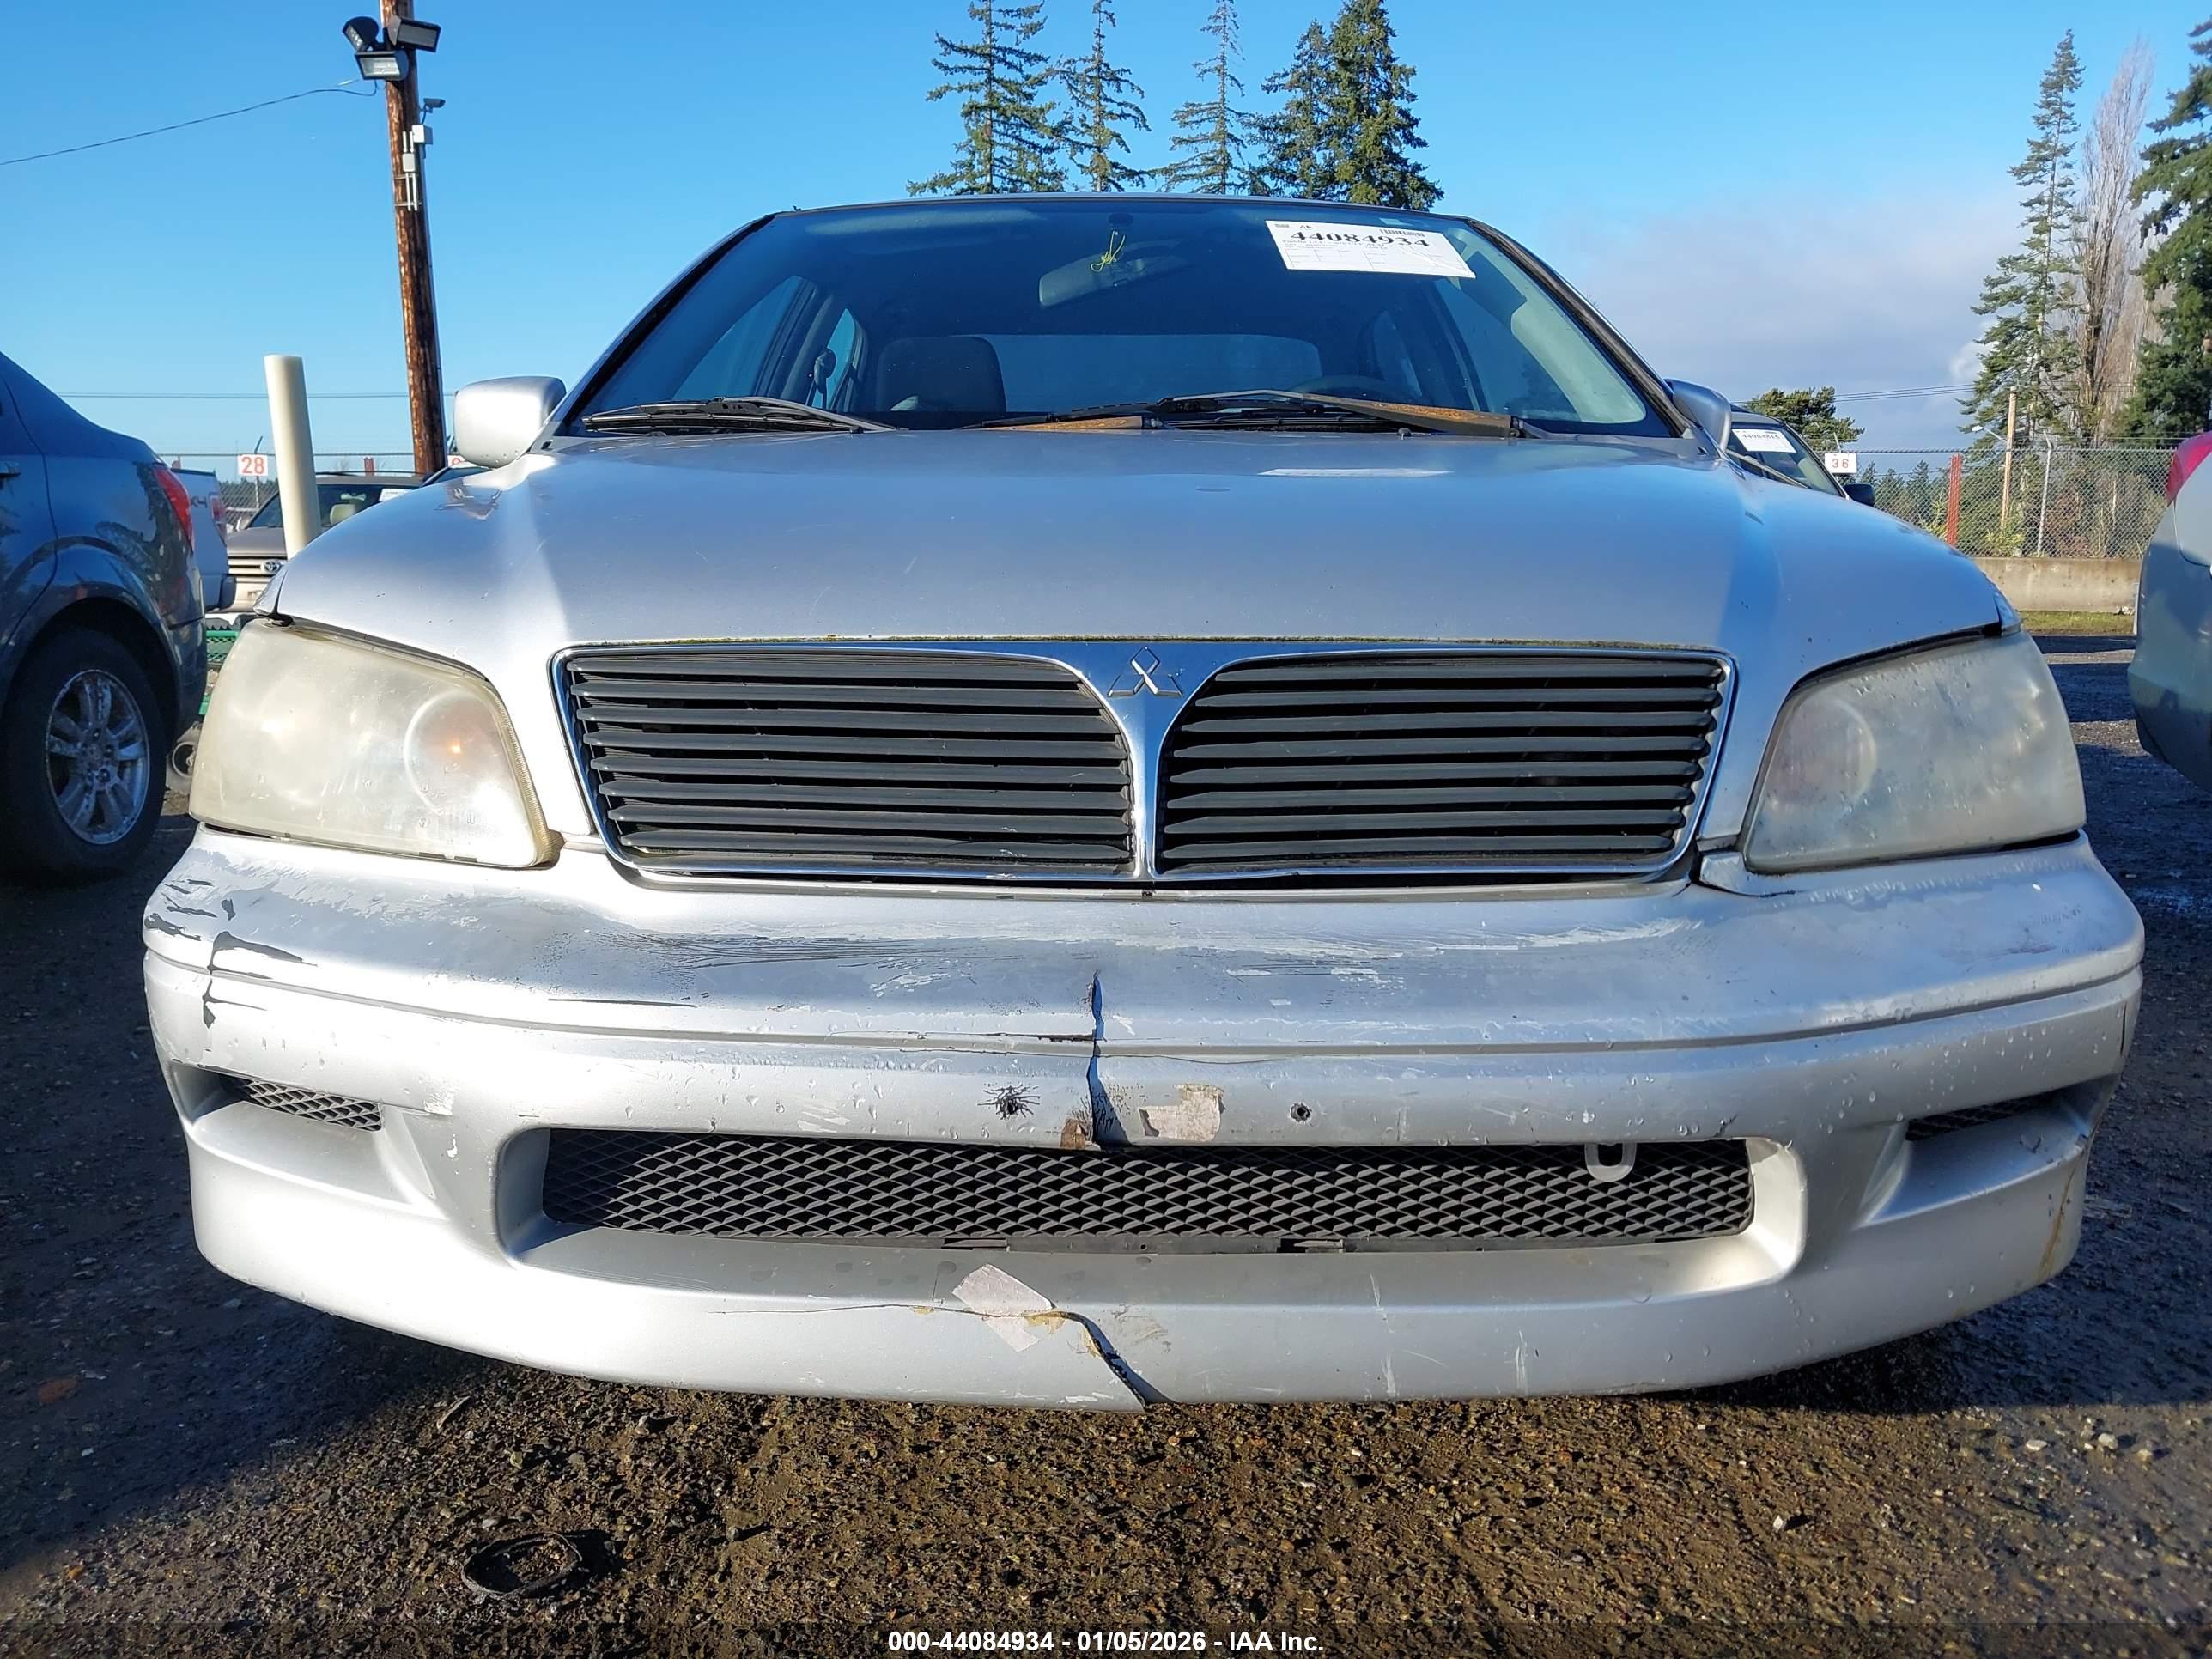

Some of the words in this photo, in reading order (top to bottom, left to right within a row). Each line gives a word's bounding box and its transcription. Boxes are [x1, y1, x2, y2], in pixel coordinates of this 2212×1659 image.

[1291, 231, 1430, 248] 44084934
[241, 456, 265, 475] 28
[1832, 458, 1850, 469] 36
